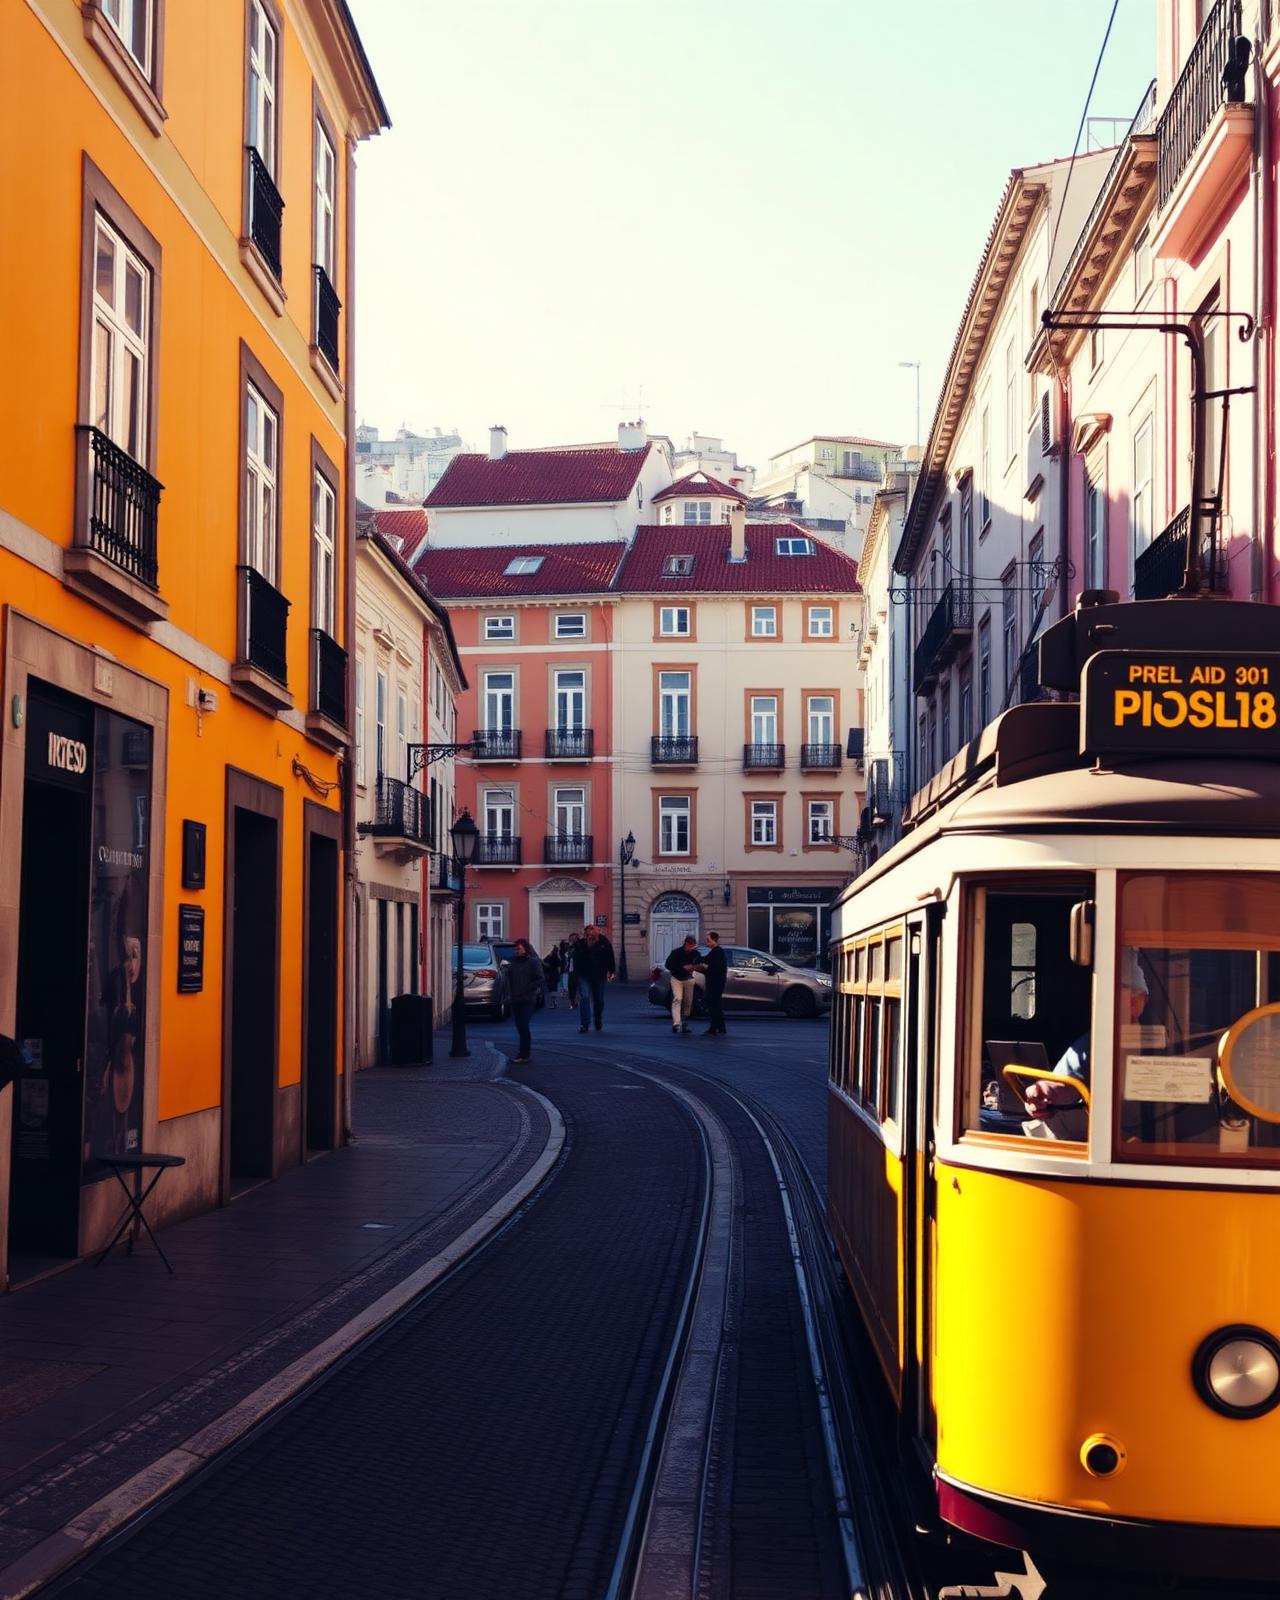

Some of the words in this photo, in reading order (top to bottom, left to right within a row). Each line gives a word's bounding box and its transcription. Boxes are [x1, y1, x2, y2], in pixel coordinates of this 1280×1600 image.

[1129, 665, 1182, 684] PREL
[1190, 666, 1226, 684] AID
[1235, 667, 1269, 685] 301
